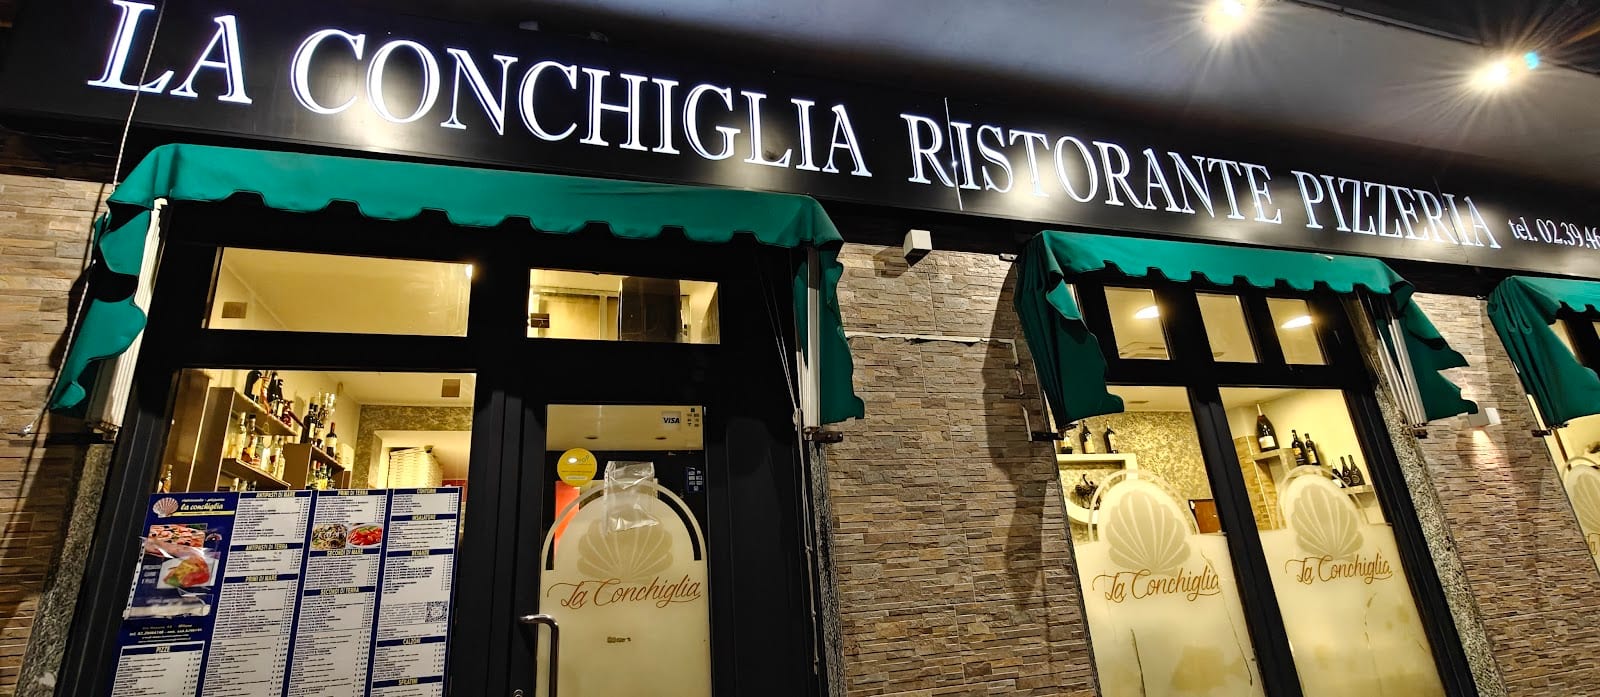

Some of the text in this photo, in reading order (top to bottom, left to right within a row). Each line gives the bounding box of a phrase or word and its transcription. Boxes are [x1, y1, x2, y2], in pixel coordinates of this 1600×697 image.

[87, 0, 873, 177] LA CONCHIGLIA
[900, 113, 1502, 249] RISTORANTE PIZZERIA
[1508, 217, 1538, 242] tel.
[1092, 565, 1221, 603] La Conchiglia
[1285, 552, 1394, 585] La Conchiglia
[547, 574, 701, 610] La Conchiglia
